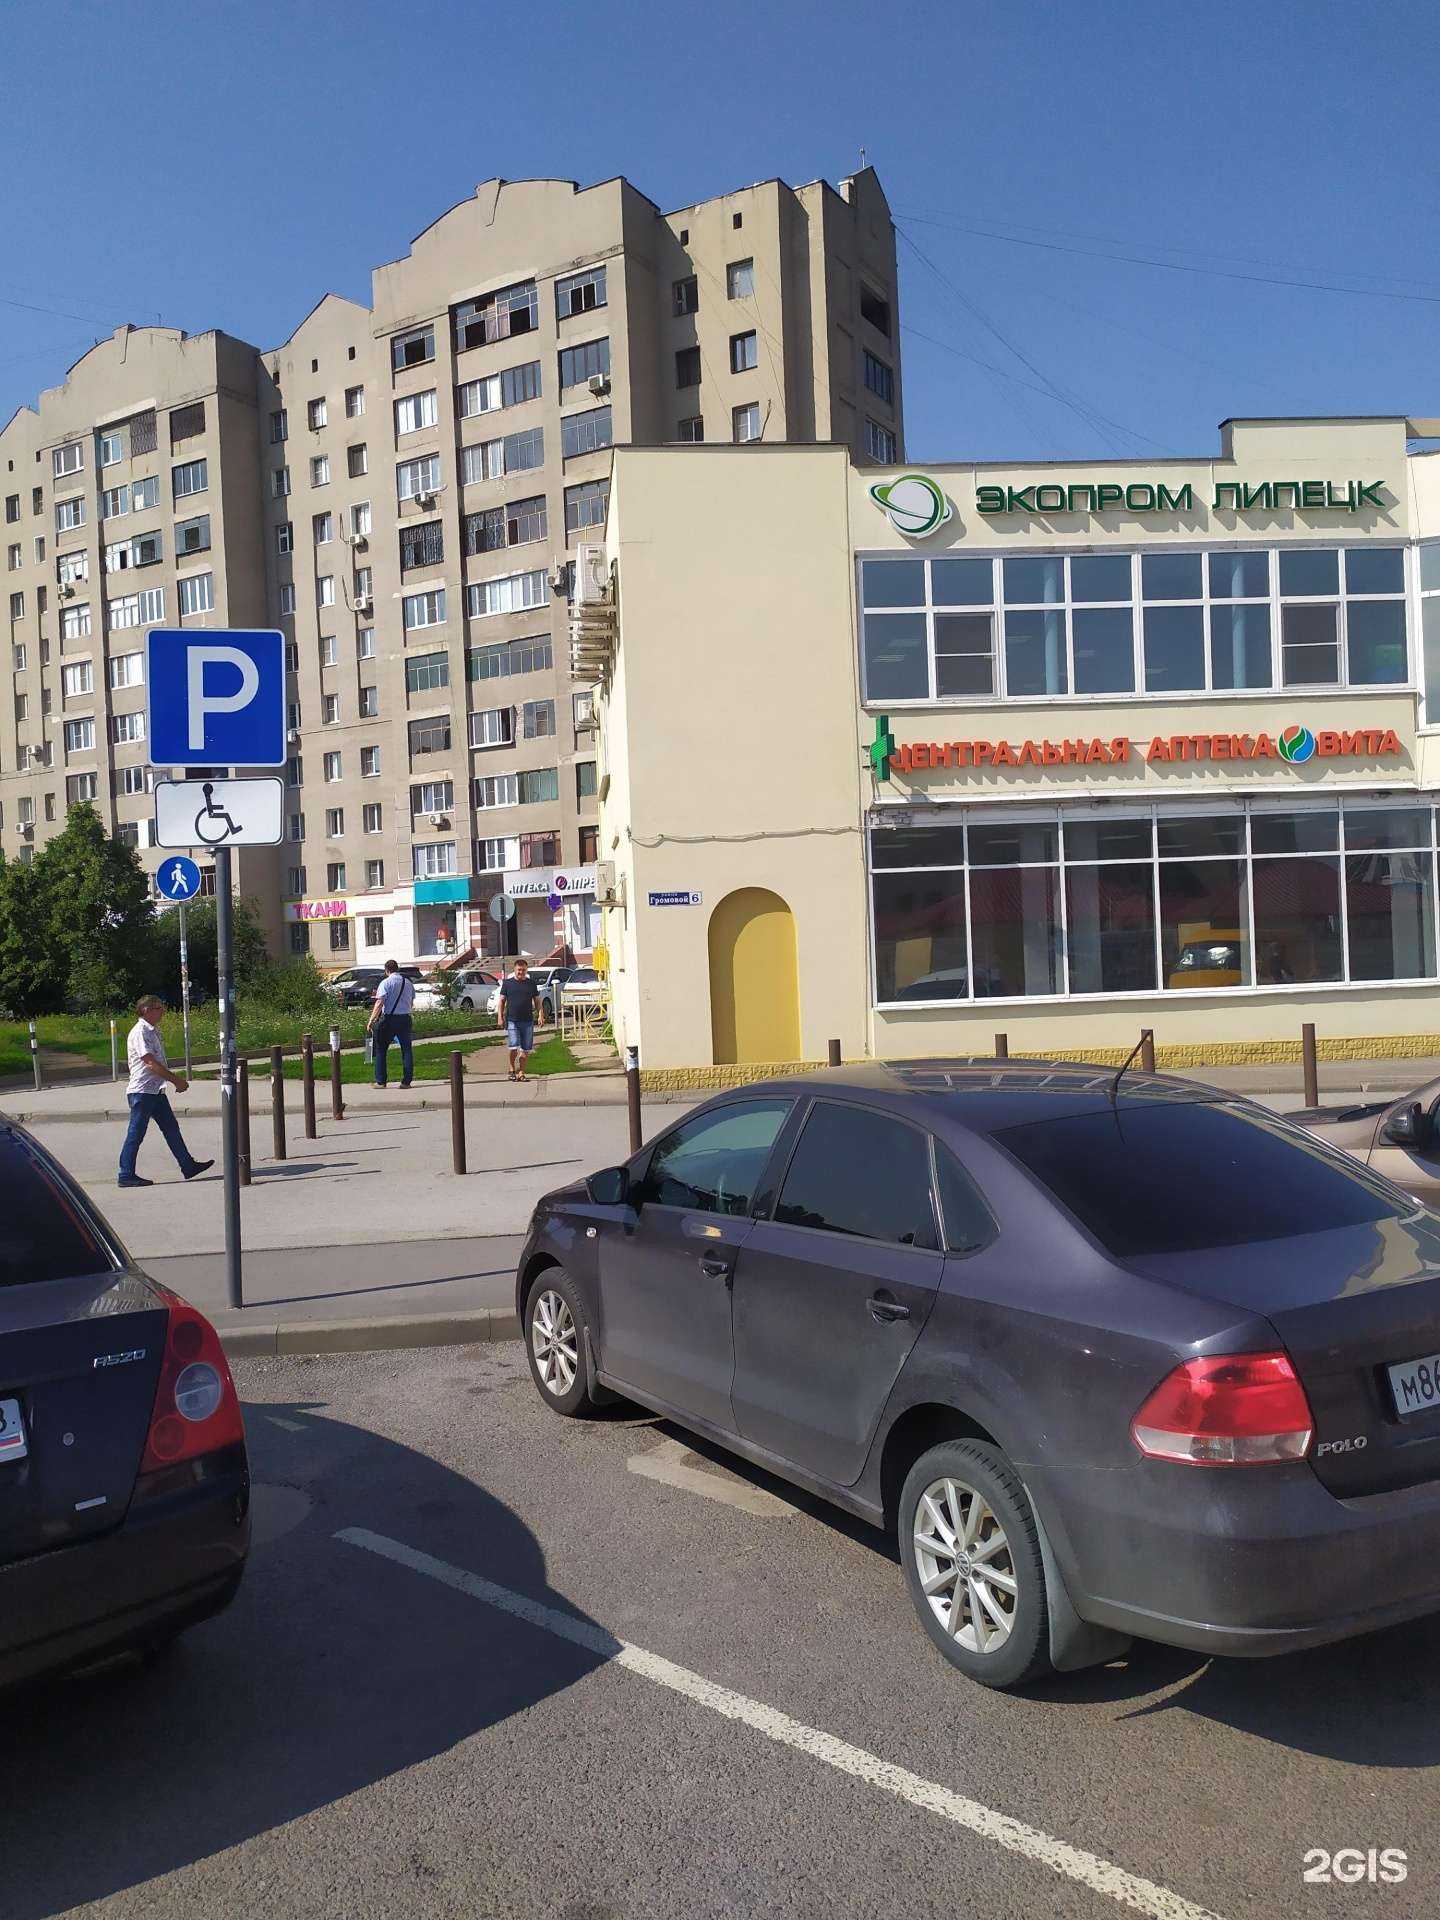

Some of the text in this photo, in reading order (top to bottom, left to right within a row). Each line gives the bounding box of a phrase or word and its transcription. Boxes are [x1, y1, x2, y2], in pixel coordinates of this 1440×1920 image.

[975, 480, 1387, 514] ЭКОПРОМ ЛИПЕЦК
[187, 646, 260, 750] P
[889, 729, 1402, 774] ЦЕНТРАЛЬНАЯ АПТЕКА ВИТА
[508, 882, 550, 895] АПТЕКА
[293, 900, 347, 919] ТКАНИ
[650, 893, 700, 906] Громовой 6
[1317, 1436, 1368, 1457] POLO
